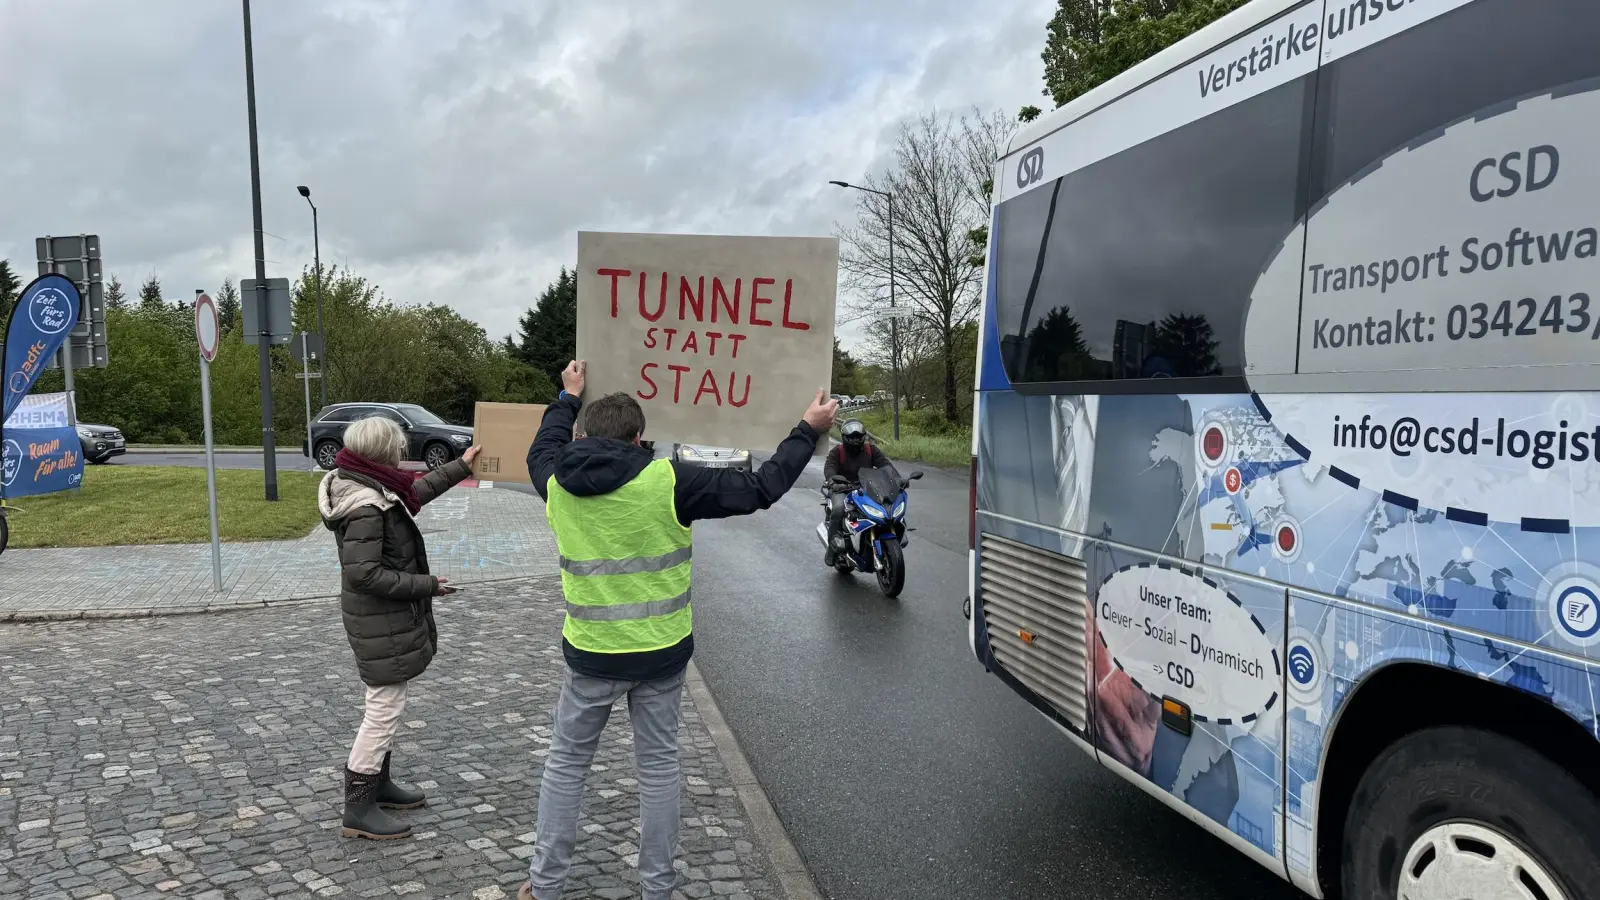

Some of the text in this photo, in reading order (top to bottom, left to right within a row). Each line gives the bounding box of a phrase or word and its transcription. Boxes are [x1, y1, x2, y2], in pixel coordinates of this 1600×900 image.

[1199, 0, 1416, 98] Verstärke uns
[1469, 144, 1560, 203] CSD
[1308, 227, 1598, 294] Transport Softwa
[36, 294, 58, 306] Zeit
[40, 305, 65, 318] fürs
[597, 268, 811, 331] TUNNEL
[42, 316, 64, 328] Rad
[1313, 309, 1436, 349] Kontakt:
[643, 327, 747, 359] STATT
[636, 362, 752, 408] STAU
[28, 438, 60, 460] Raum
[33, 450, 78, 482] für alle!
[1139, 585, 1212, 623] Unser Team:
[1101, 602, 1133, 629] Clever
[1144, 617, 1177, 646] Sozial
[1190, 633, 1264, 680] Dynamisch
[1167, 661, 1195, 689] CSD
